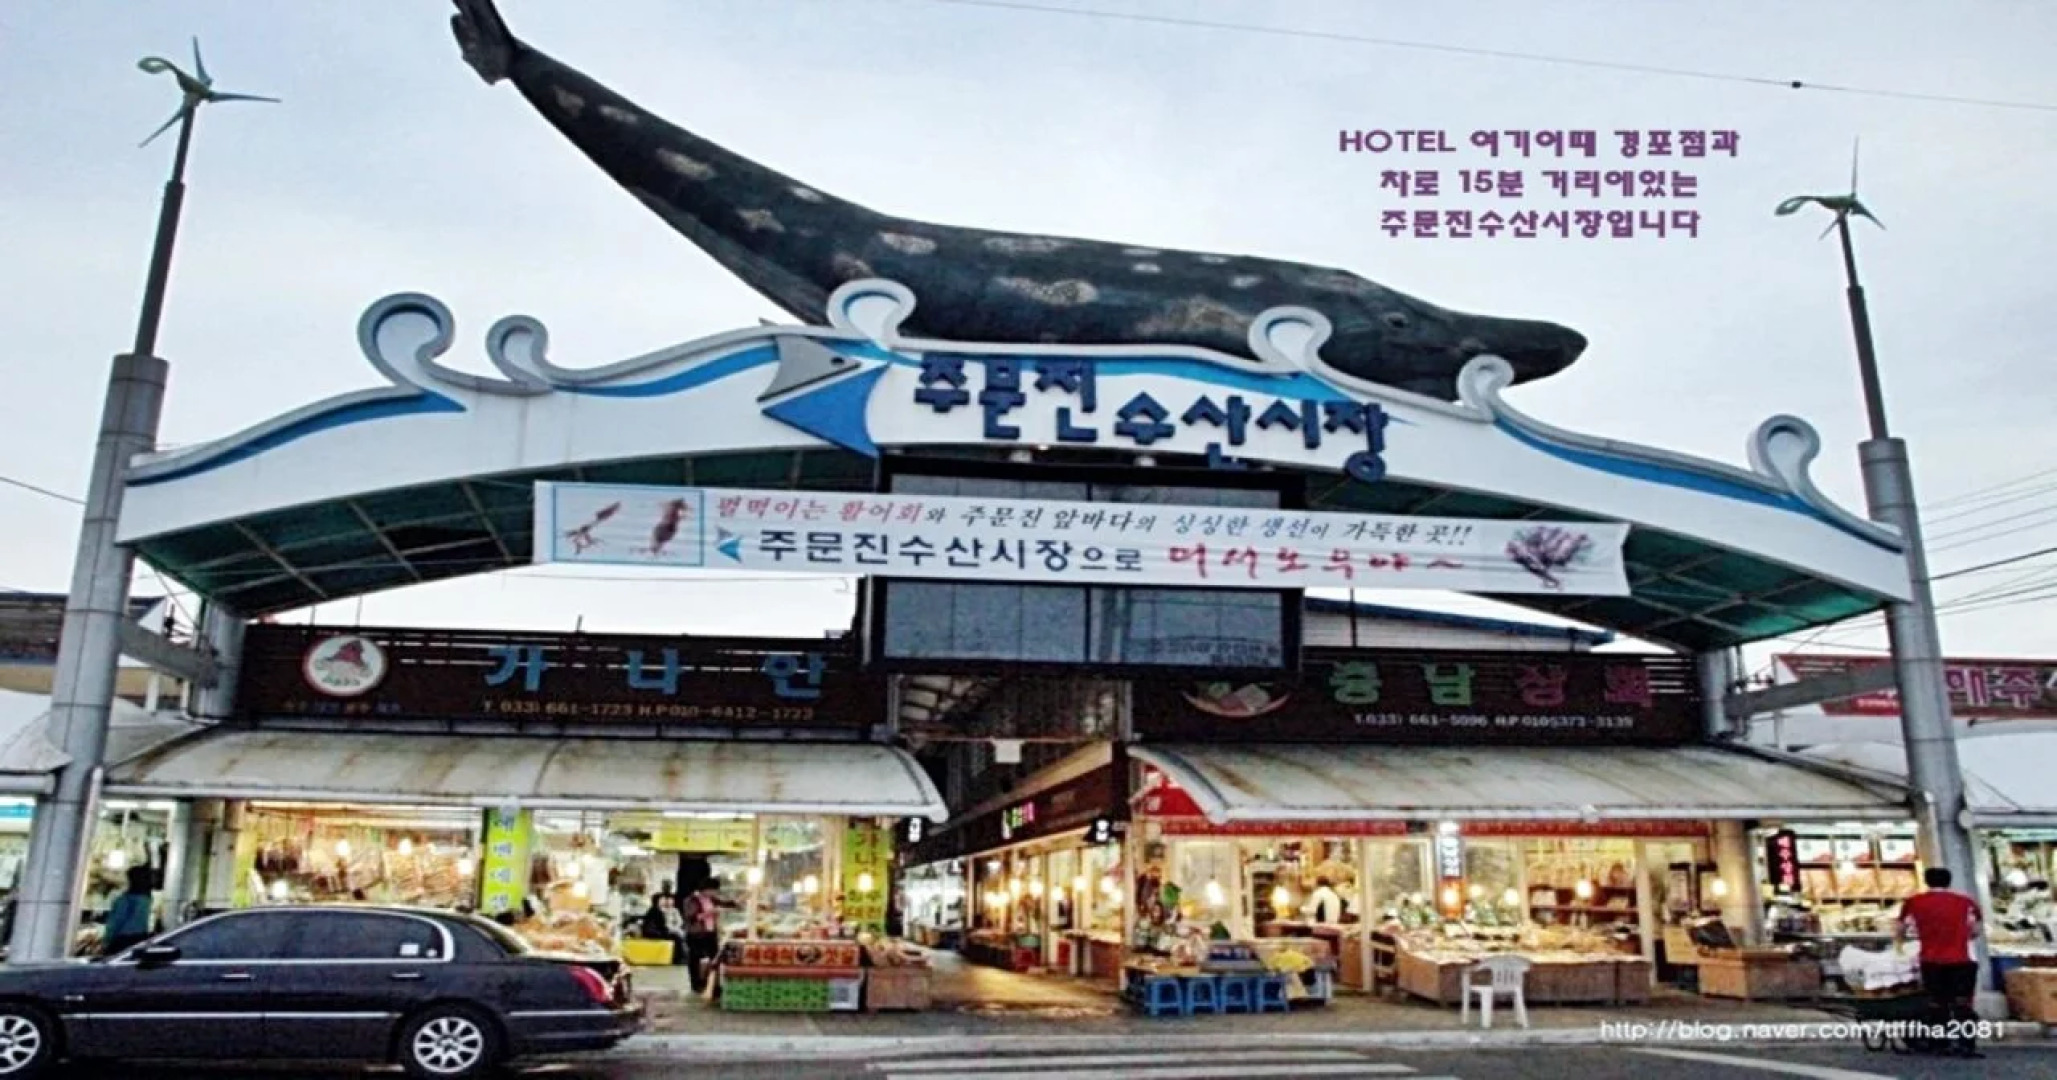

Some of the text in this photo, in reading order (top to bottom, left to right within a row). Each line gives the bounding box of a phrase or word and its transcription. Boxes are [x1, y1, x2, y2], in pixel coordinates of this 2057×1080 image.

[961, 505, 1043, 529] 주문진
[1053, 507, 1157, 534] 앞바다의
[1175, 513, 1250, 537] 싱싱한
[1260, 515, 1331, 540] 생선이
[1343, 520, 1420, 543] 가득한
[759, 528, 1143, 573] 주문진수산시장으로
